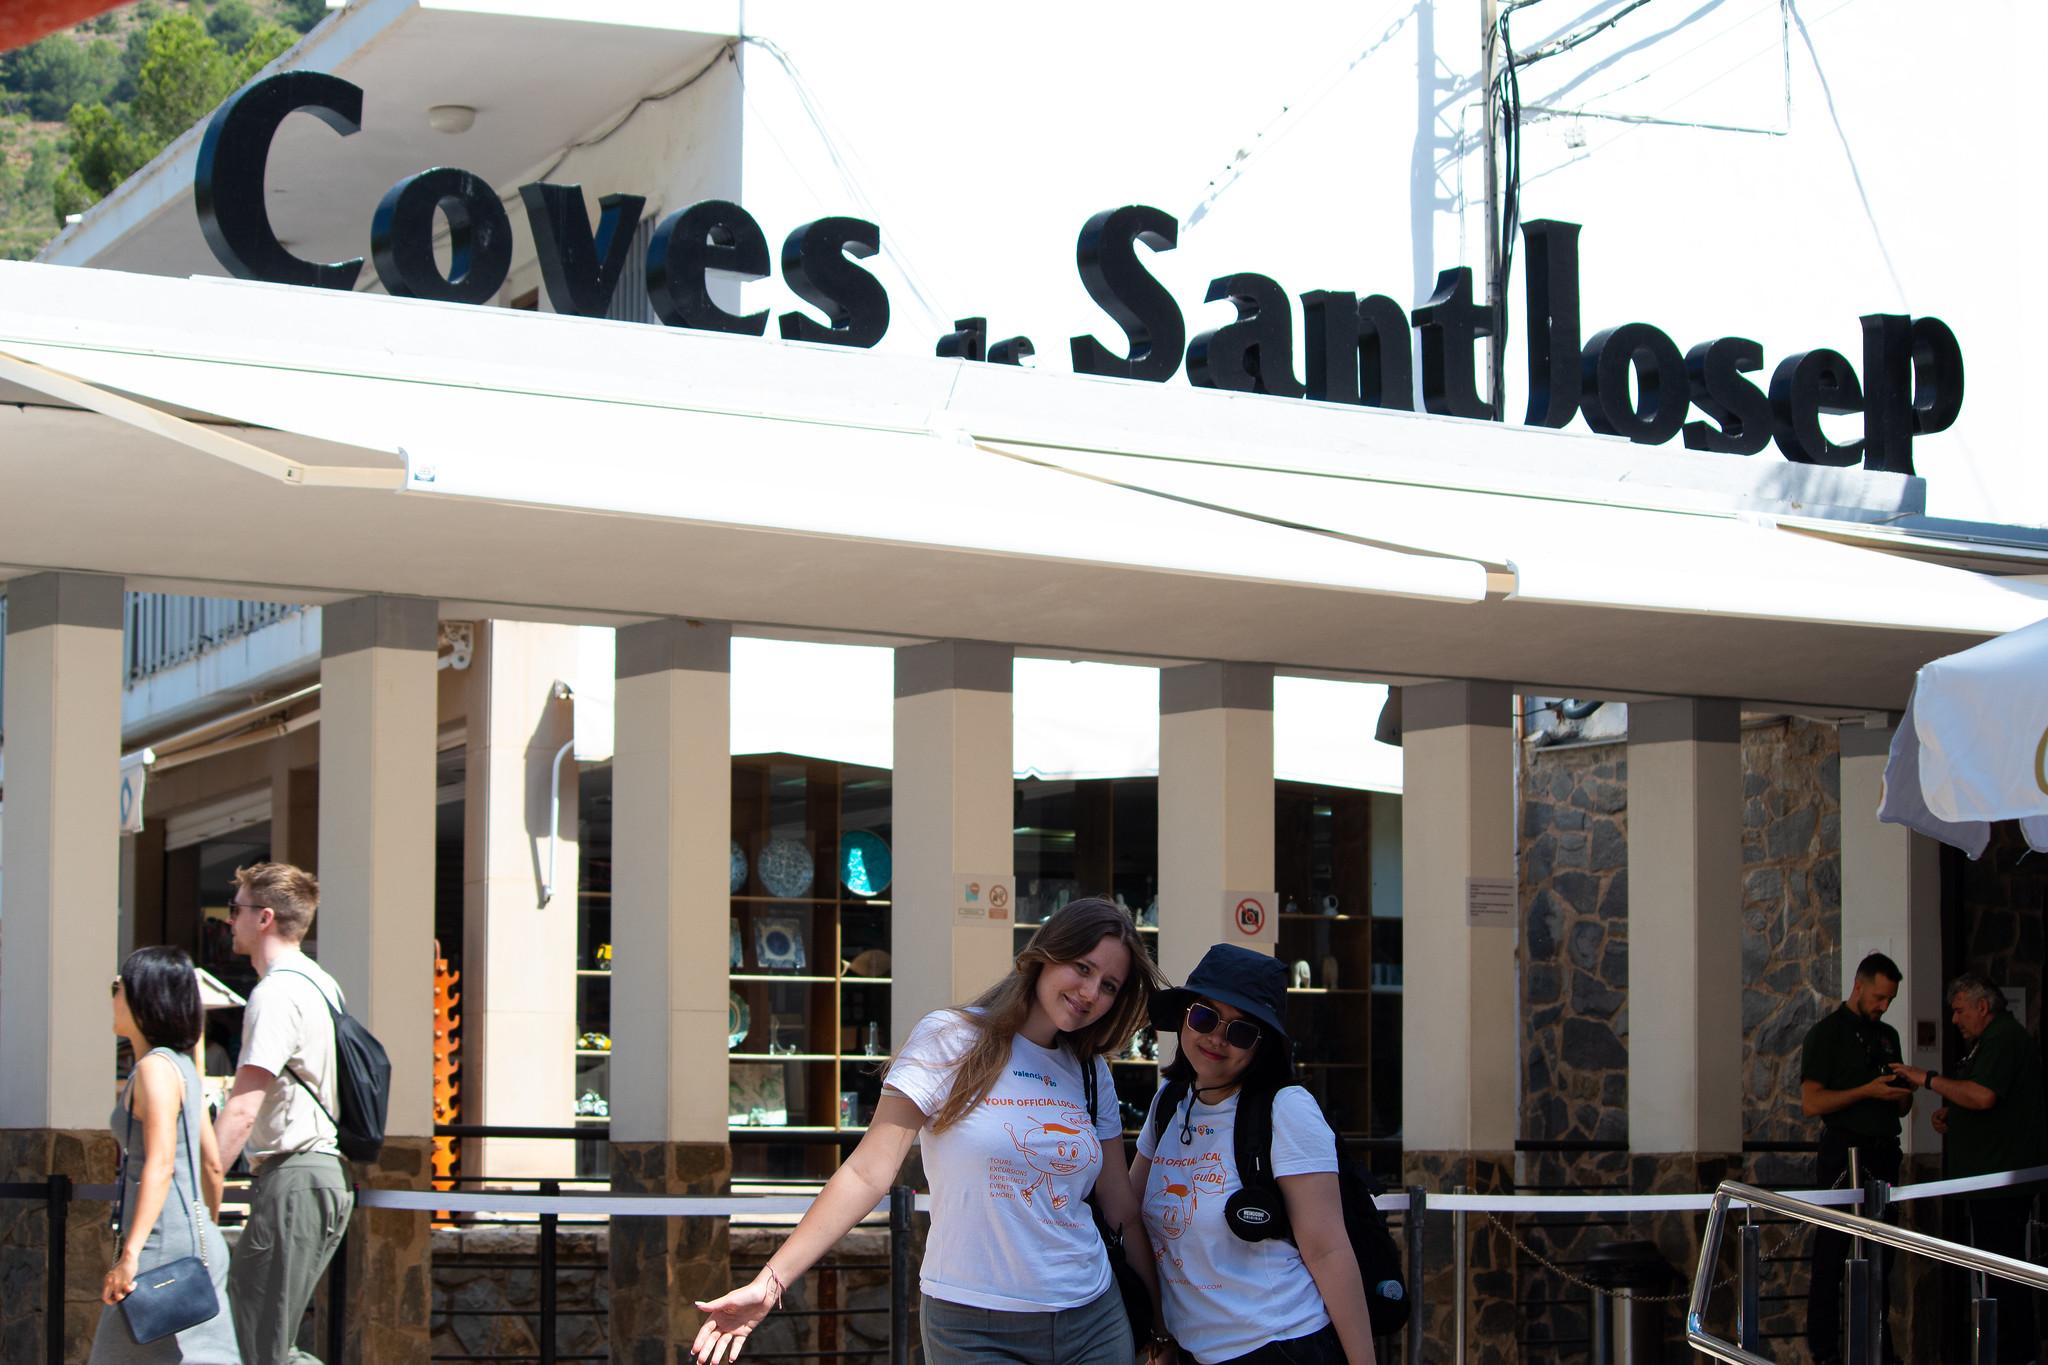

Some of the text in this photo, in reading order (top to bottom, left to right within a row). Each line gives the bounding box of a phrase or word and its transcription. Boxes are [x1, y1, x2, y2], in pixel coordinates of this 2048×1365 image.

[194, 69, 1965, 476] Coves de Sant Josep
[984, 1097, 1015, 1106] YOUR
[1017, 1098, 1057, 1107] OFFICIAL
[990, 1166, 1028, 1176] EXCURSIONS
[1194, 1172, 1223, 1184] GUIDE
[990, 1183, 1014, 1191] EVENTS
